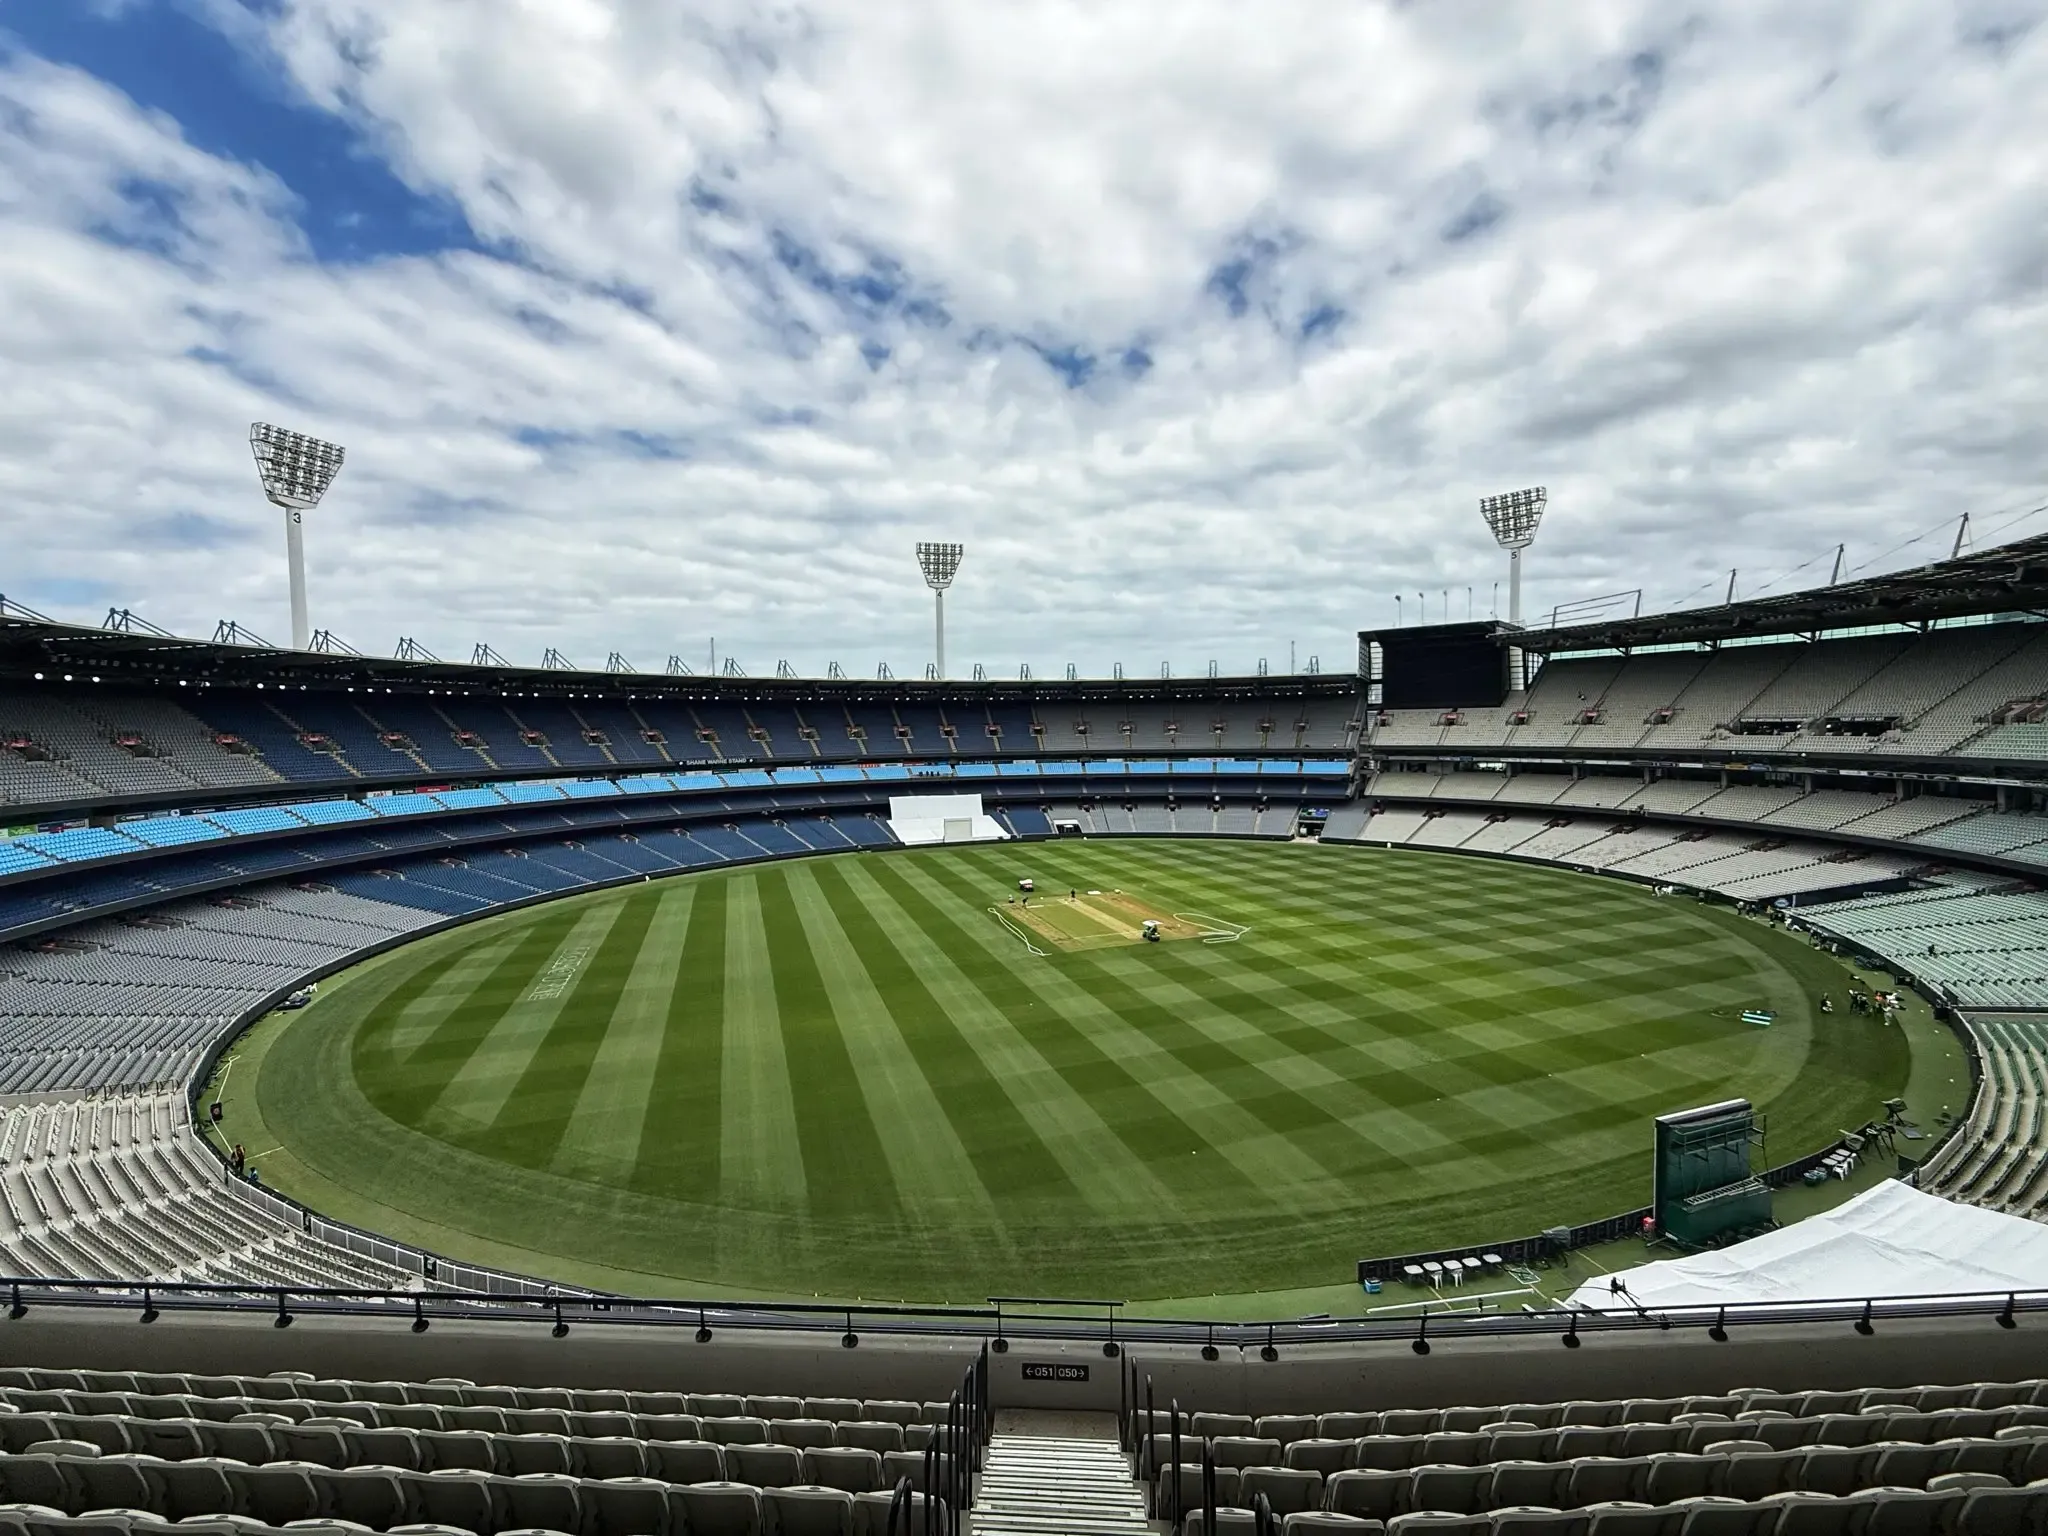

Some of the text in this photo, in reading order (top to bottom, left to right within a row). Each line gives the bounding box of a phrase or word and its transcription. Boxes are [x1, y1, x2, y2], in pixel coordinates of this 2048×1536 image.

[293, 512, 301, 524] 3
[1511, 551, 1518, 560] 5
[1034, 1367, 1053, 1377] Q51
